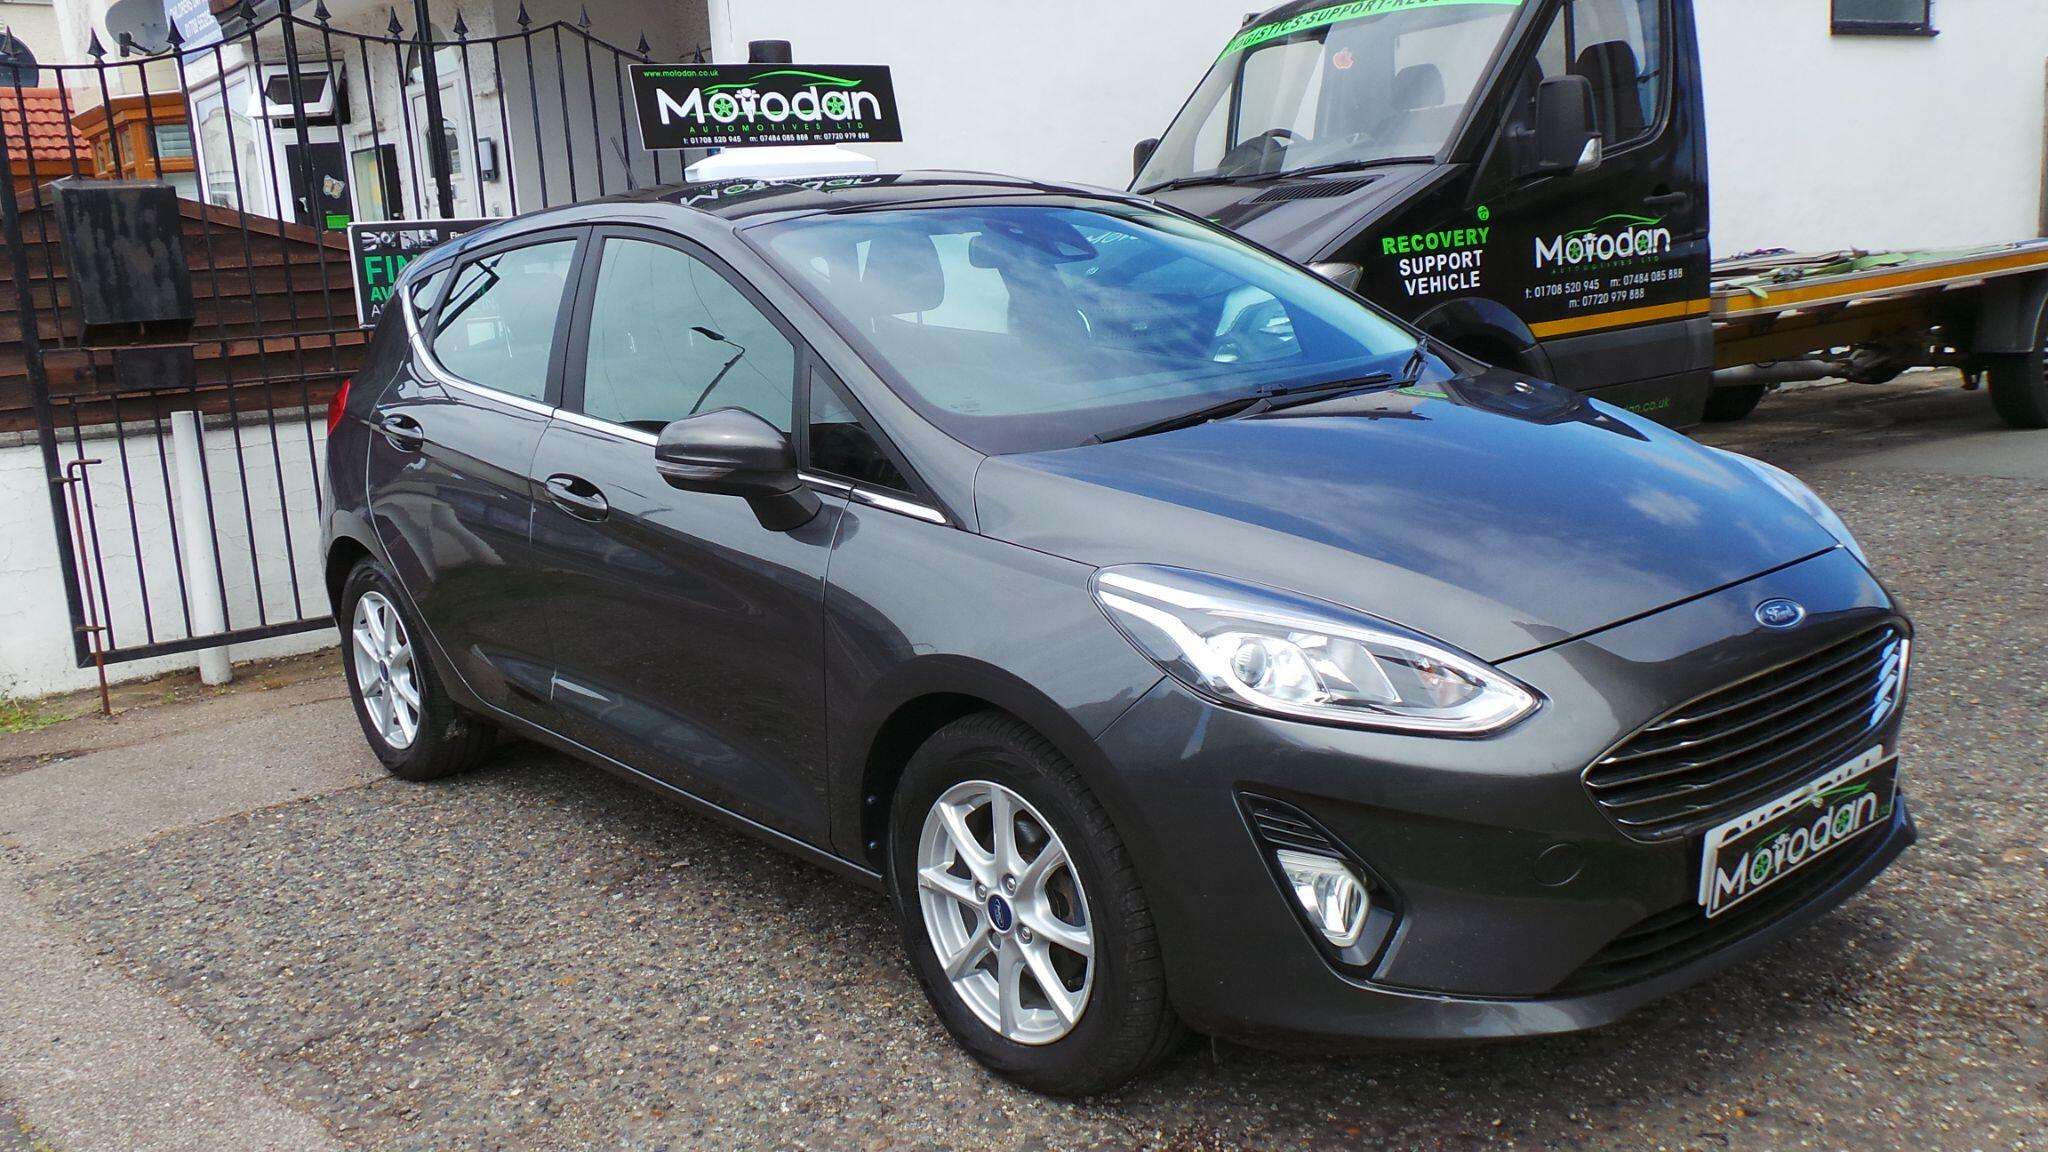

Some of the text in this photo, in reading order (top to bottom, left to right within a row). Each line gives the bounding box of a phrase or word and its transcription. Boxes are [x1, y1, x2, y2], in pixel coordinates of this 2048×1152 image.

[643, 69, 719, 77] www.motodan.co.uk
[656, 86, 882, 125] Motodan
[689, 121, 863, 134] AUTOMOTIVES LTD
[1382, 226, 1490, 255] RECOVERY
[1534, 226, 1672, 269] Motodan
[1399, 249, 1483, 276] SUPPORT
[1404, 270, 1481, 296] VEHICLE
[1534, 283, 1563, 298] 01708
[1565, 280, 1581, 294] 520
[1583, 278, 1600, 291] 945
[1623, 272, 1649, 286] 07484
[1668, 267, 1683, 280] 888
[1582, 292, 1609, 307] 07720
[1610, 290, 1627, 302] 979
[1629, 287, 1645, 300] 888
[1712, 791, 1878, 910] Motodan
